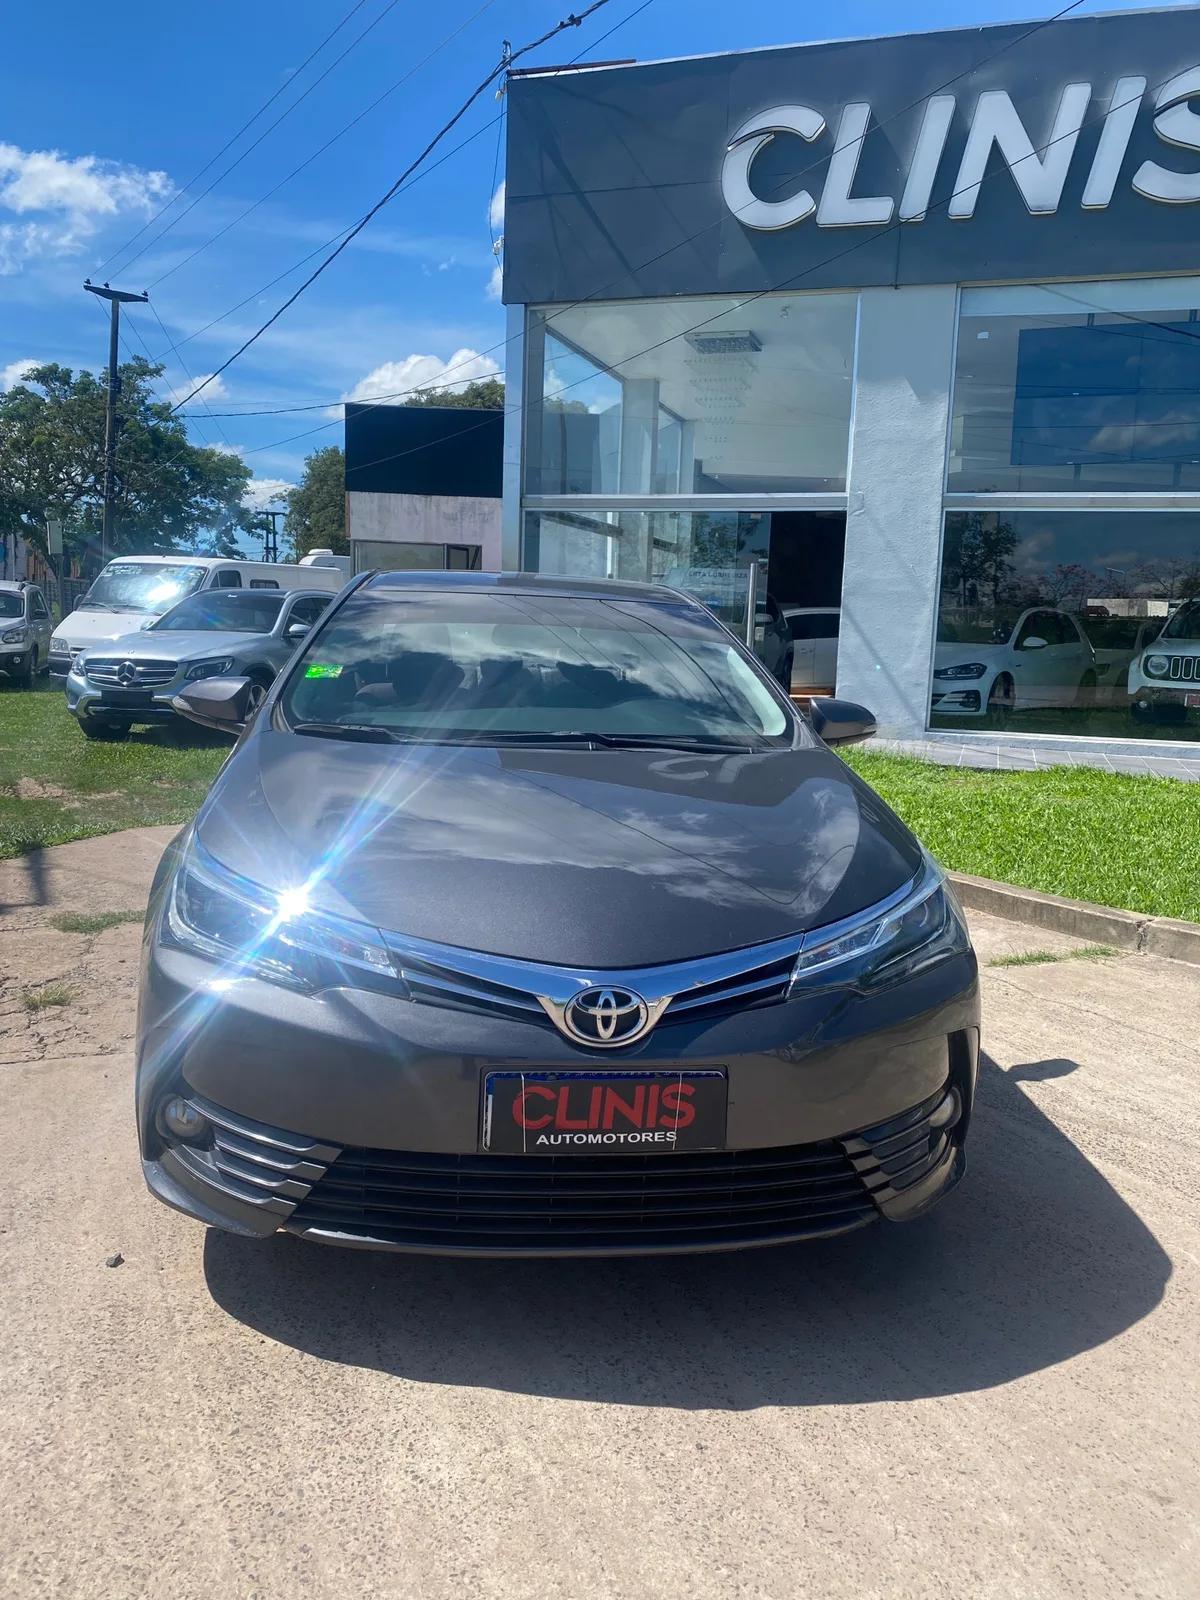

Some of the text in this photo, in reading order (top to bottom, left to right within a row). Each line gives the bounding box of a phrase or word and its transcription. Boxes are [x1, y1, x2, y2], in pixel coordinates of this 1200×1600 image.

[721, 64, 1200, 231] CLINIS
[512, 1083, 696, 1130] CLINIS
[536, 1131, 677, 1145] AUTOMOTORES
